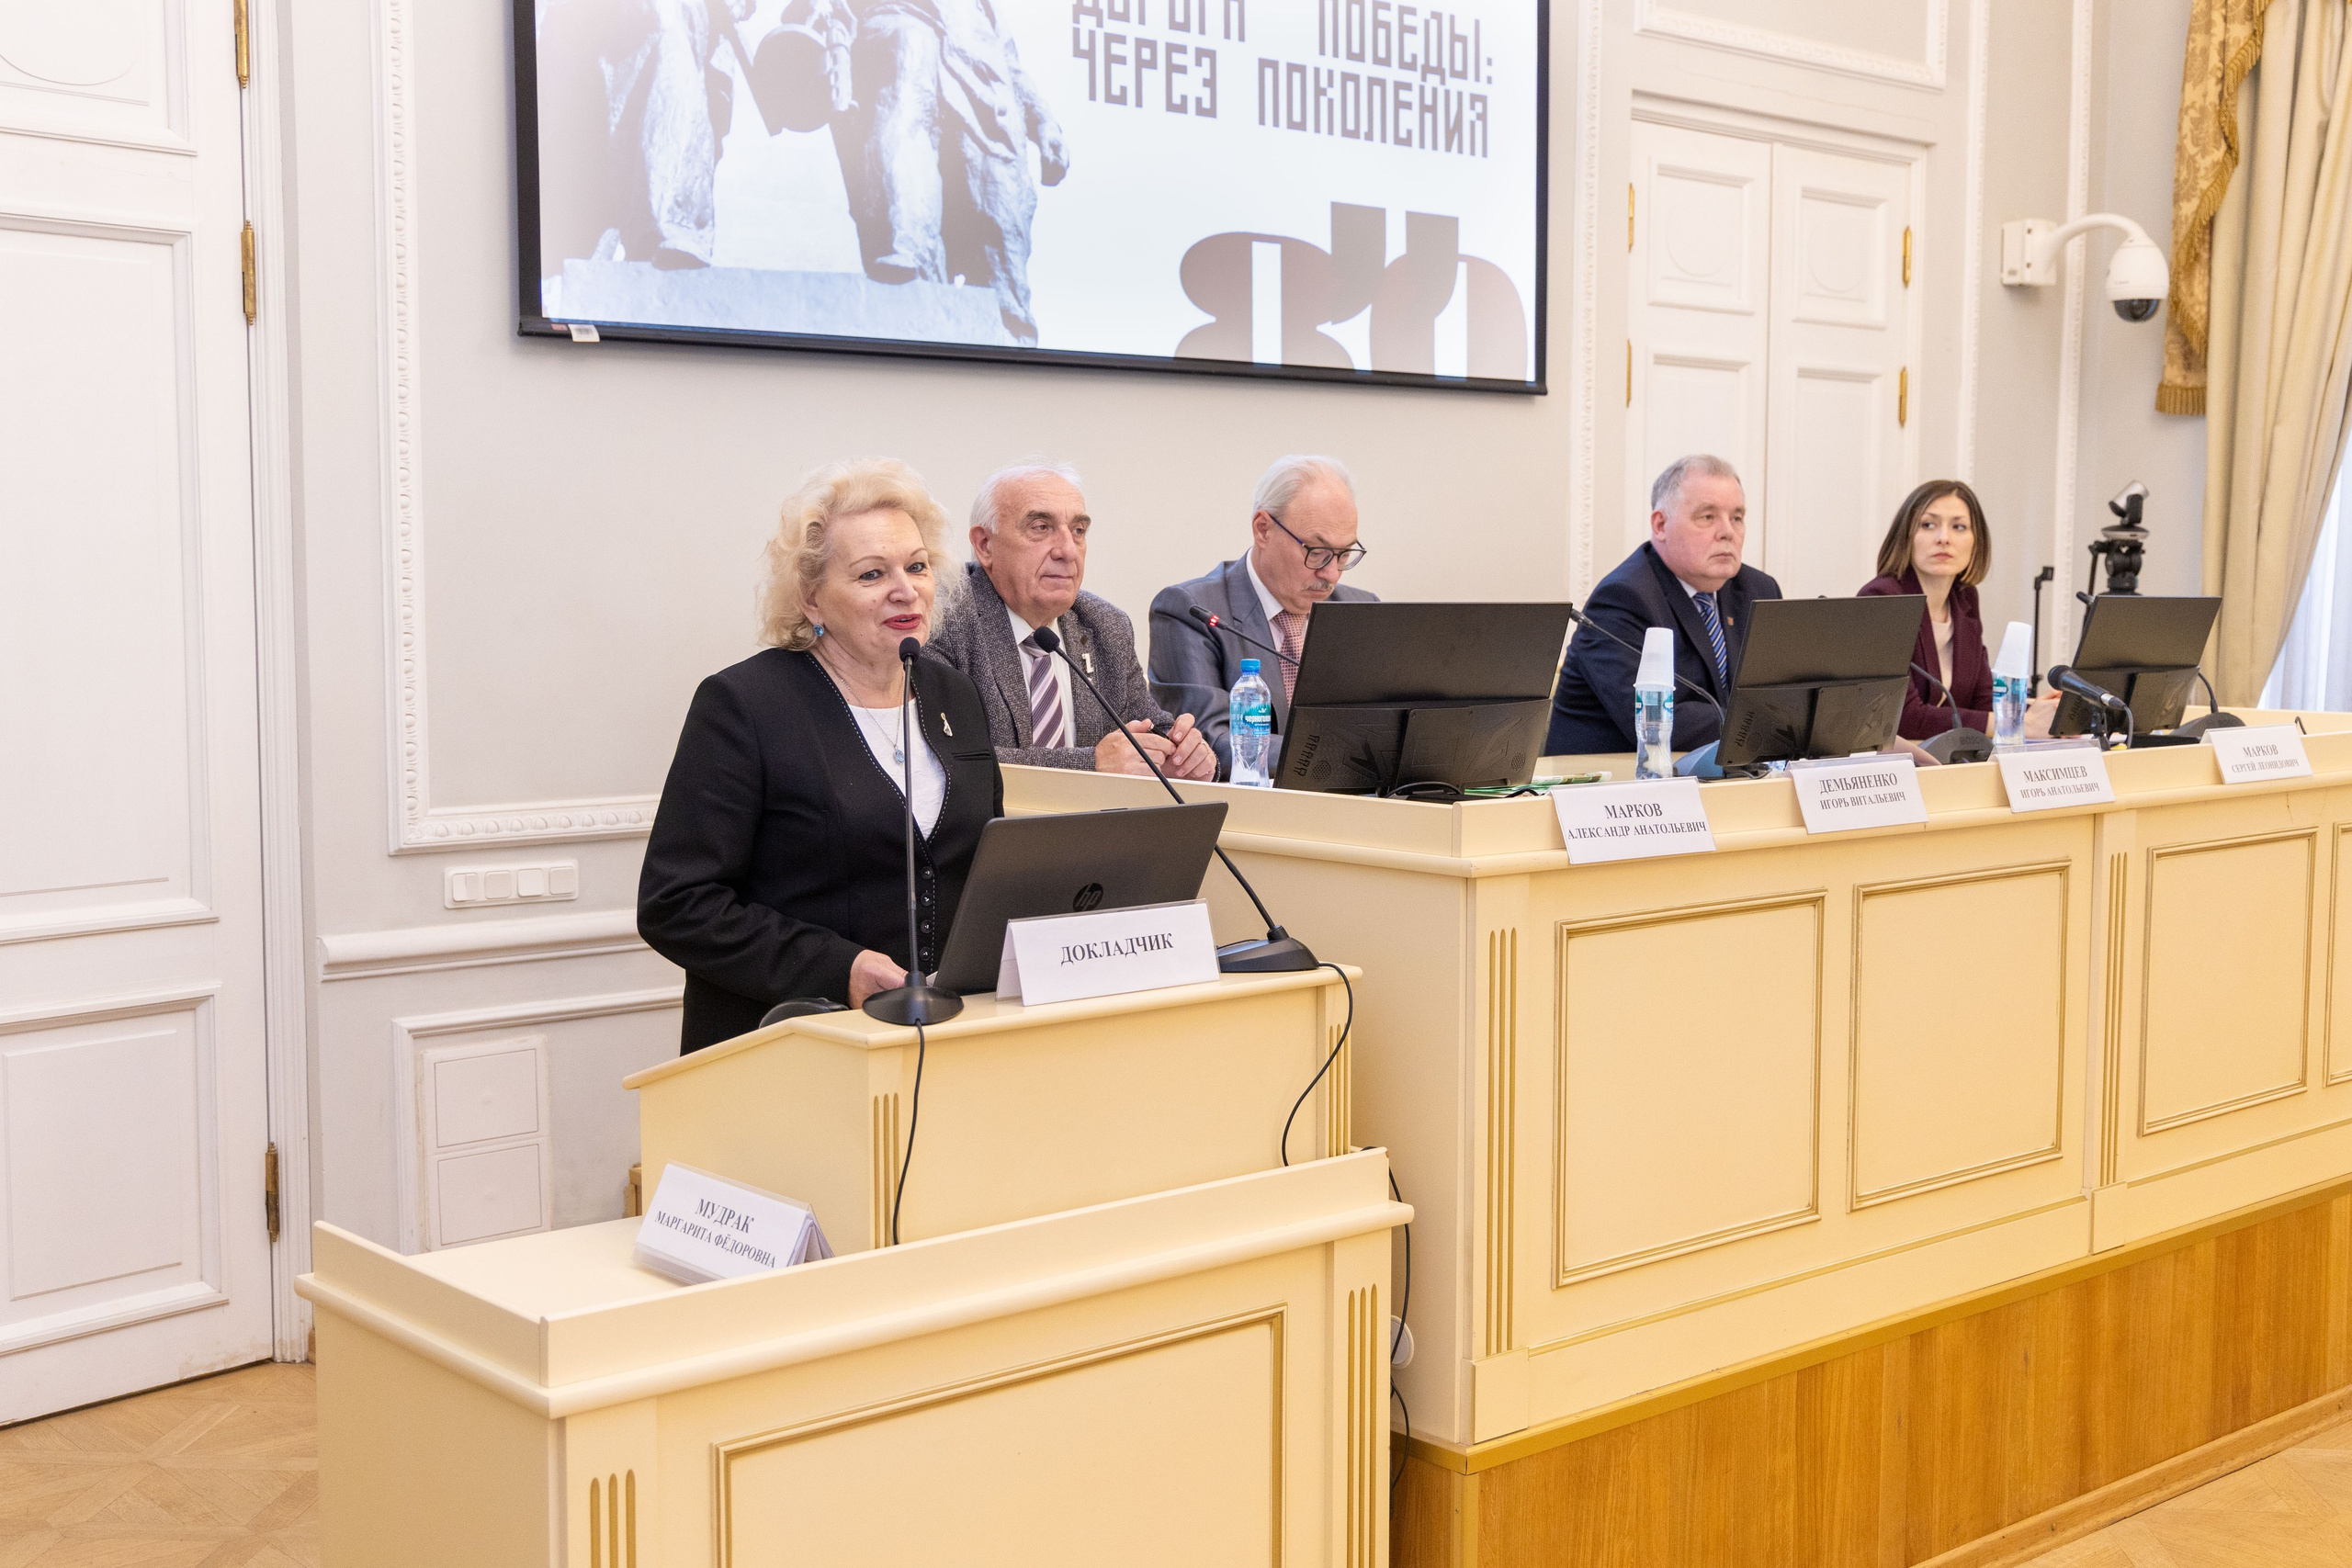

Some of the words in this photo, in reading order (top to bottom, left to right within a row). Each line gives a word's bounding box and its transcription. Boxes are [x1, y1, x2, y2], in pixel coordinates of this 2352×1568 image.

[1318, 0, 1493, 85] ПОБЕДЫ:
[1071, 27, 1218, 119] ЧЕРЕЗ
[1257, 57, 1488, 159] ПОКОЛЕНИЯ
[2243, 744, 2278, 758] МАРКОВ
[2022, 765, 2088, 783] МАКСИМЦЕВ
[2231, 761, 2256, 773] СЕРГЕЙ
[2257, 758, 2300, 771] ЛЕОНИДОВИЧ
[1818, 773, 1898, 795] ДЕМЬЯНЕНКО
[2019, 787, 2046, 799] ИГОРЬ
[2047, 782, 2100, 796] АНАТОЛЬЕВИЧ
[1603, 803, 1664, 819] МАРКОВ
[1819, 797, 1849, 810] ИГОРЬ
[1851, 791, 1906, 807] ВИТАЛЬЕВИЧ
[1567, 825, 1631, 840] АЛЕКСАНДР
[1633, 820, 1708, 836] АНАТОЛЬЕВИЧ
[1074, 883, 1102, 911] hp
[1060, 932, 1174, 966] ДОКЛАДЧИК
[695, 1198, 755, 1234] МУДРАК
[654, 1210, 712, 1243] МАРГАРИТА
[713, 1234, 776, 1269] ФЁДОРОВНА
